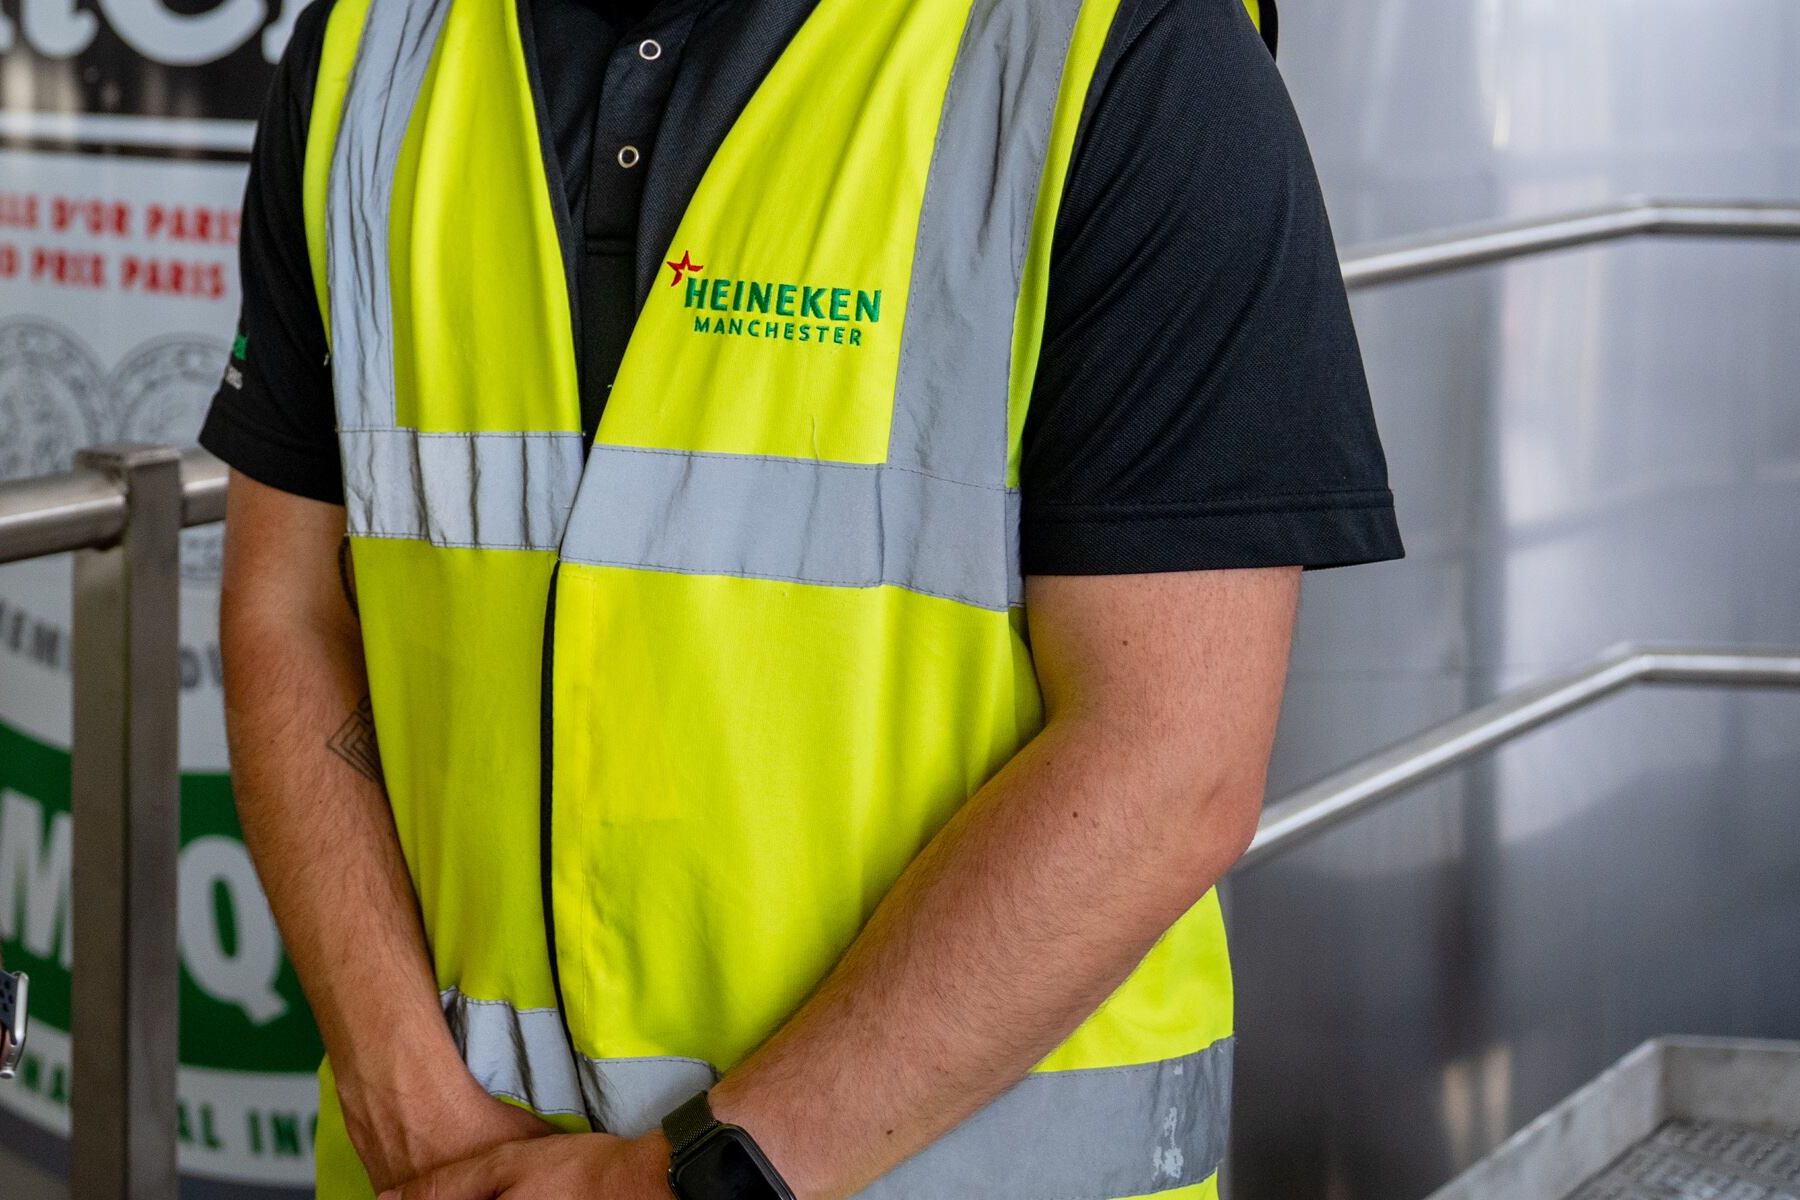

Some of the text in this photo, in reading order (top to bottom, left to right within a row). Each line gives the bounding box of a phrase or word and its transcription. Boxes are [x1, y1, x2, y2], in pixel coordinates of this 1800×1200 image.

[52, 195, 129, 241] D'OR
[31, 246, 106, 290] PRIX
[122, 254, 225, 301] PARIS
[684, 277, 882, 323] HEINEKEN
[694, 315, 863, 347] MANCHESTER
